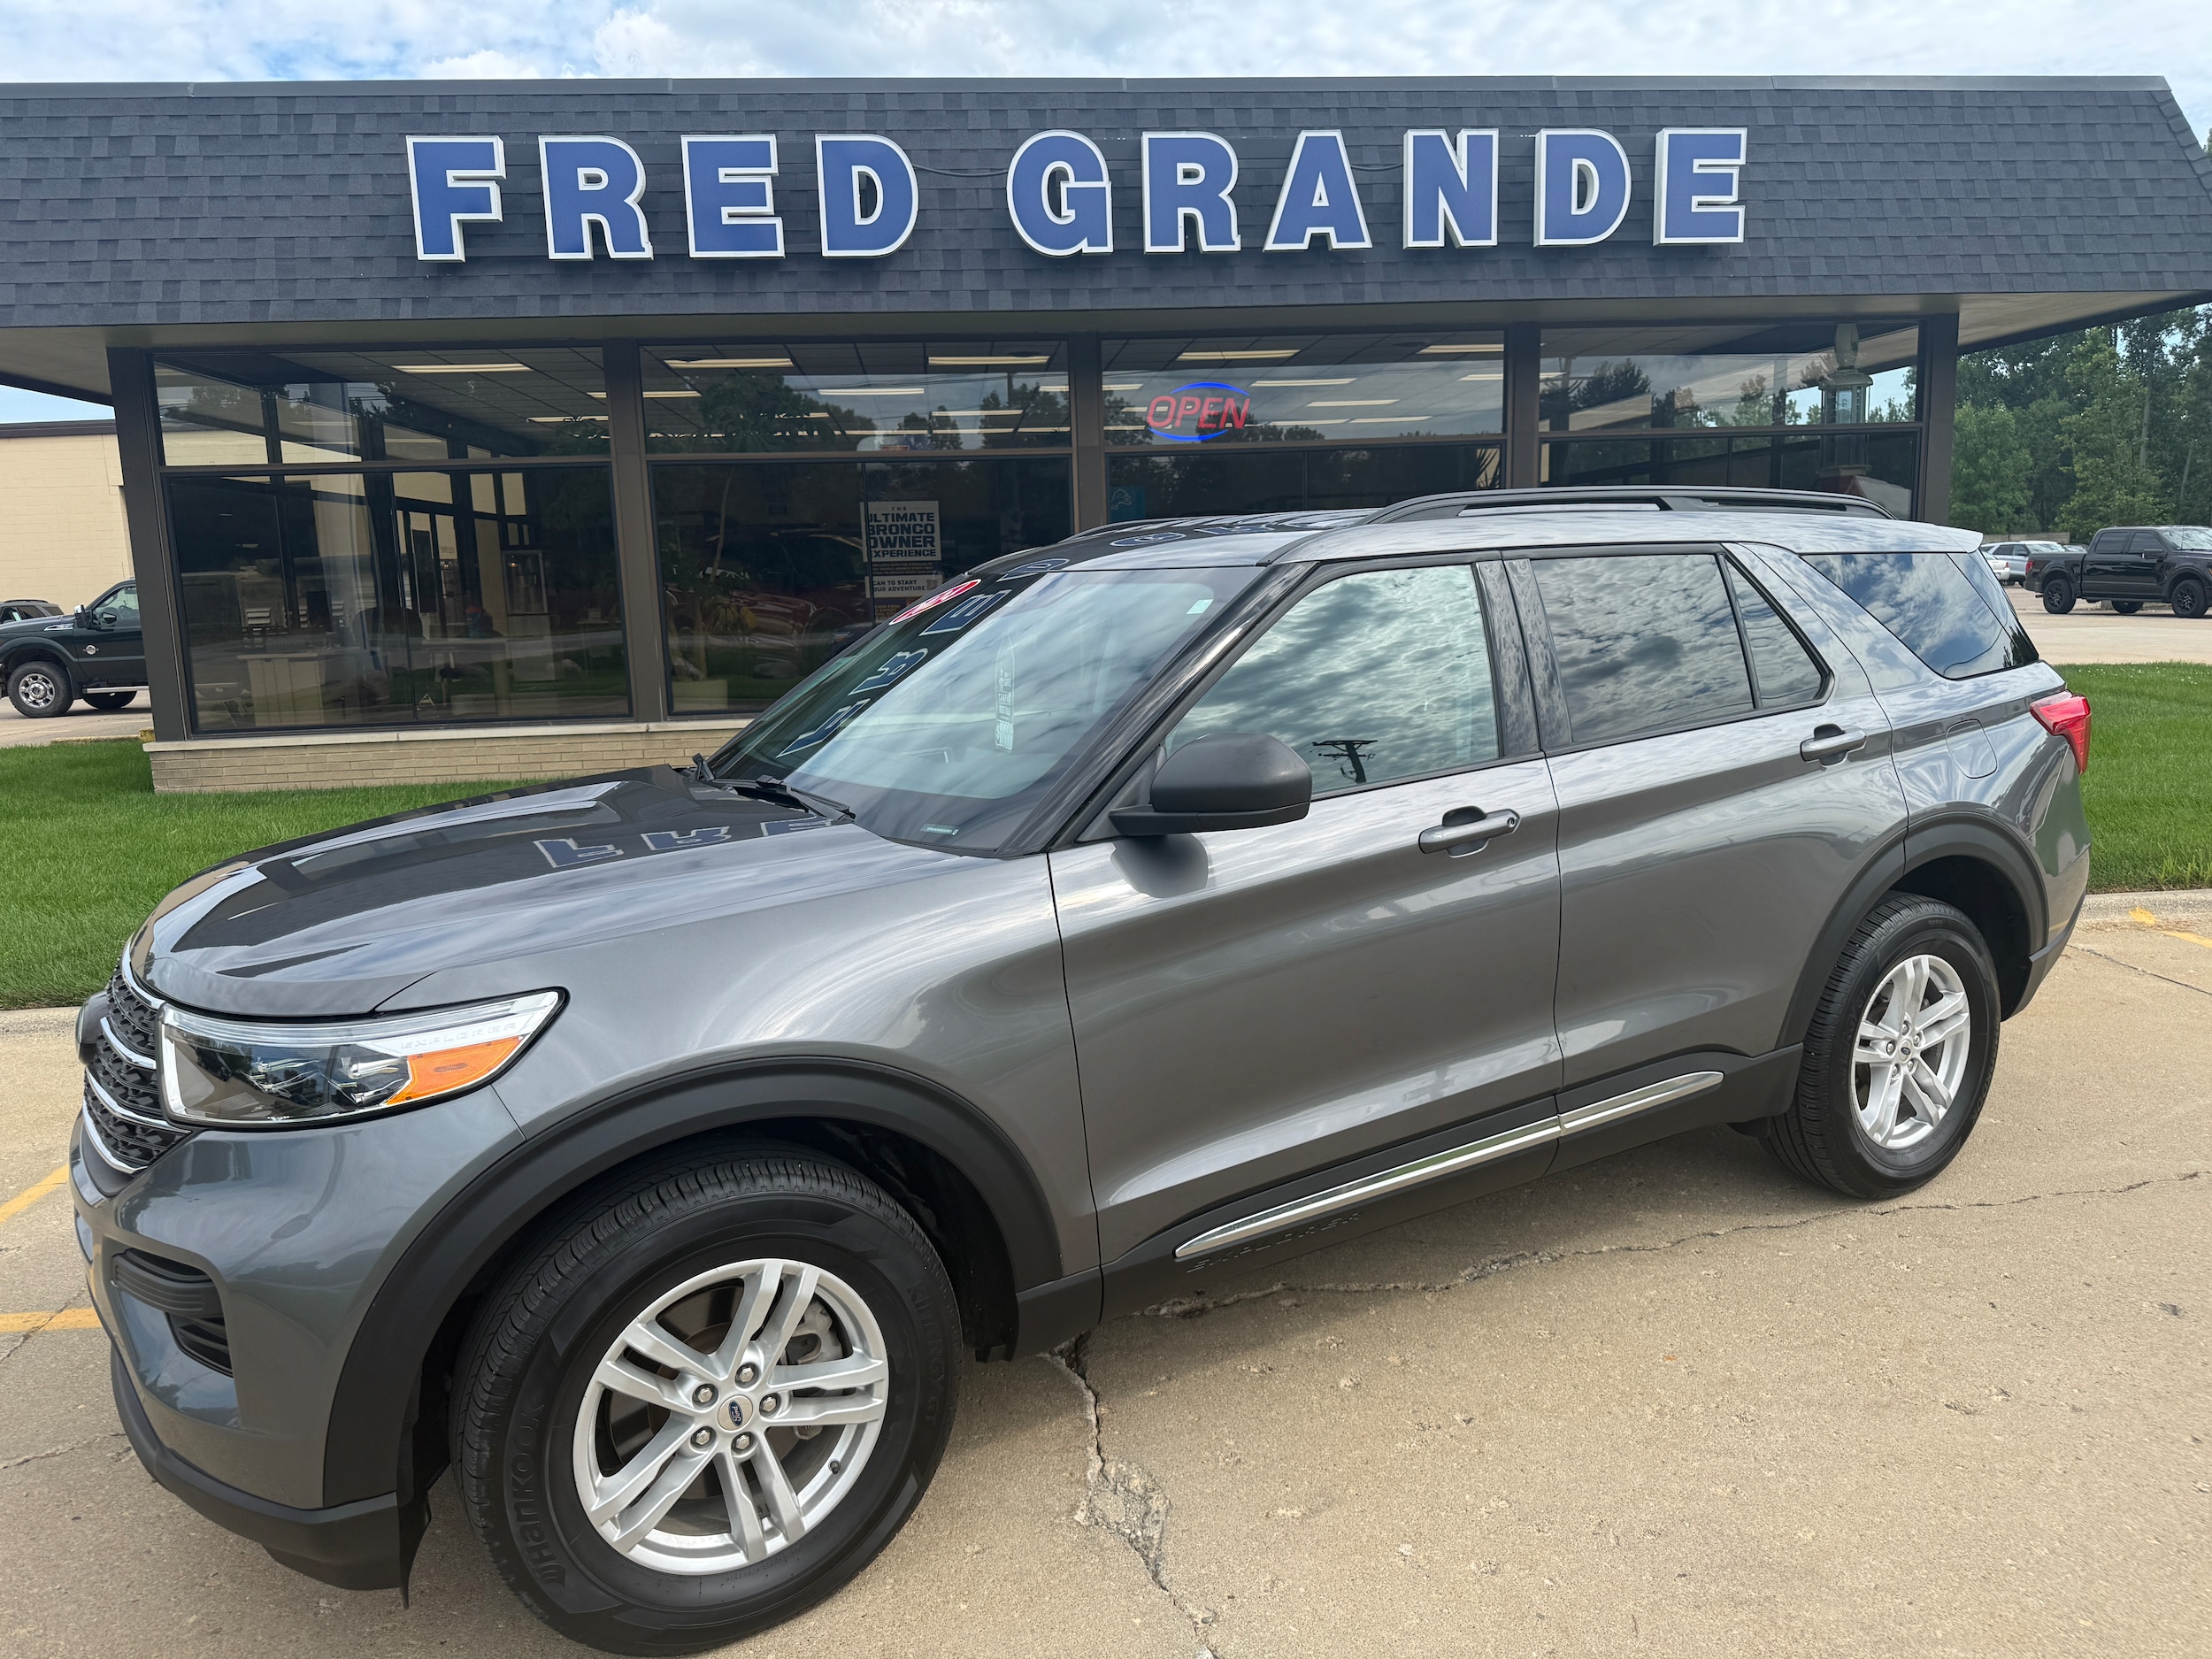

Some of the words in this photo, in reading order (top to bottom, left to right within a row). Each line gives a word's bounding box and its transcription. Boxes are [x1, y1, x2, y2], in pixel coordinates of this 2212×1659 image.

[405, 133, 920, 264] FRED
[1005, 127, 1748, 257] GRANDE
[1146, 396, 1251, 429] OPEN
[401, 1022, 517, 1049] EXPLORER
